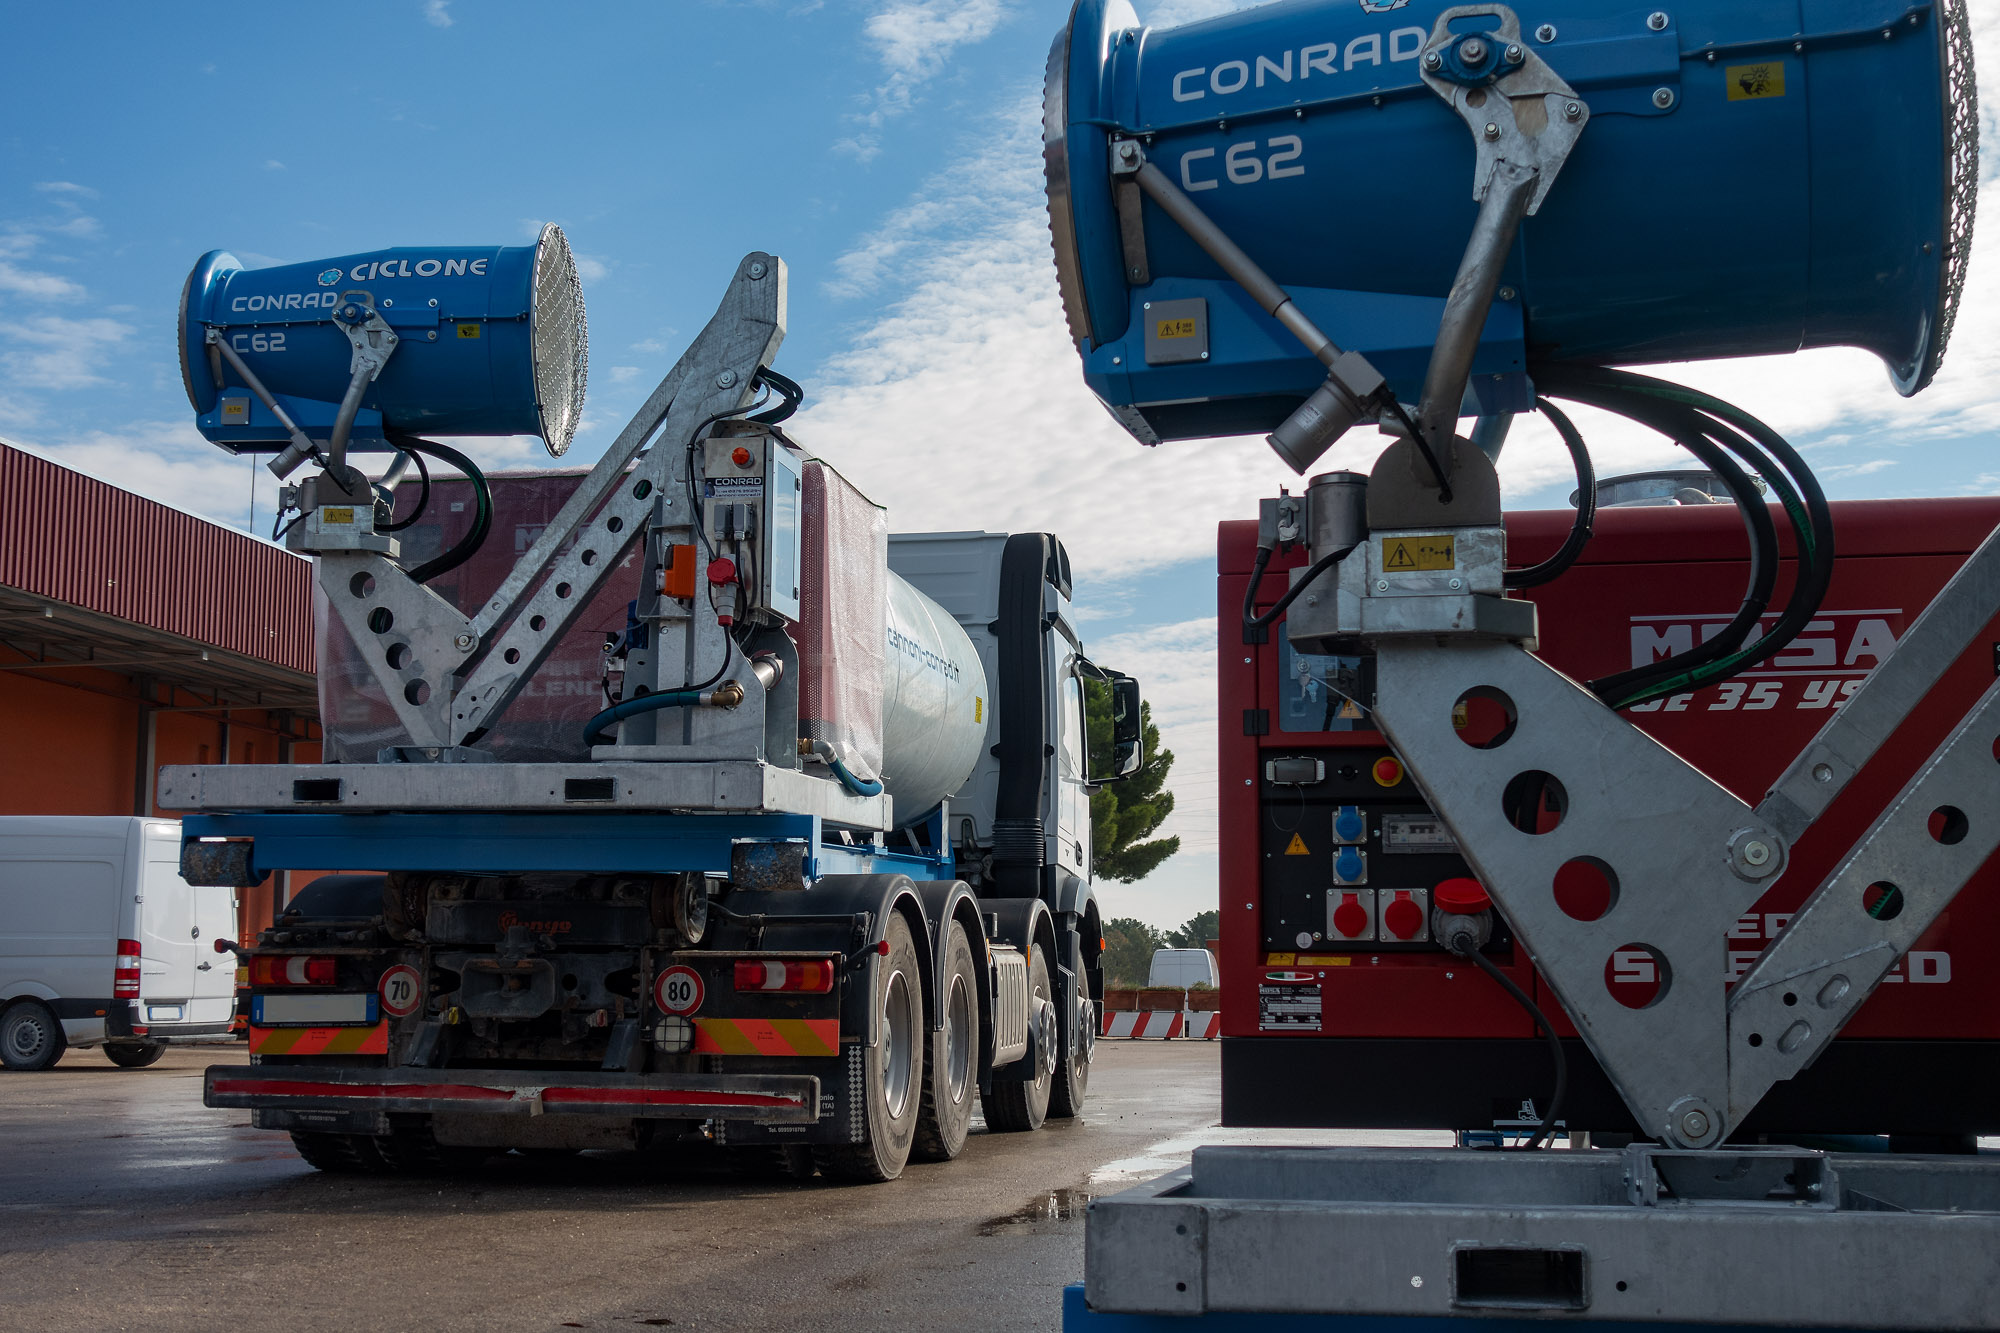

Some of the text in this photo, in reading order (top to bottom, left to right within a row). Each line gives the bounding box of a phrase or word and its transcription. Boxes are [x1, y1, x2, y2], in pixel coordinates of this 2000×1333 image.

[1172, 26, 1428, 103] CONRAD
[1180, 134, 1305, 193] C62
[350, 258, 489, 282] CICLONE
[231, 291, 338, 313] CONRAD
[232, 332, 287, 354] C62
[715, 477, 762, 486] CONRAD
[1706, 681, 1784, 711] 35
[391, 980, 411, 1001] 70
[667, 981, 691, 1002] 80
[819, 1093, 834, 1101] onio
